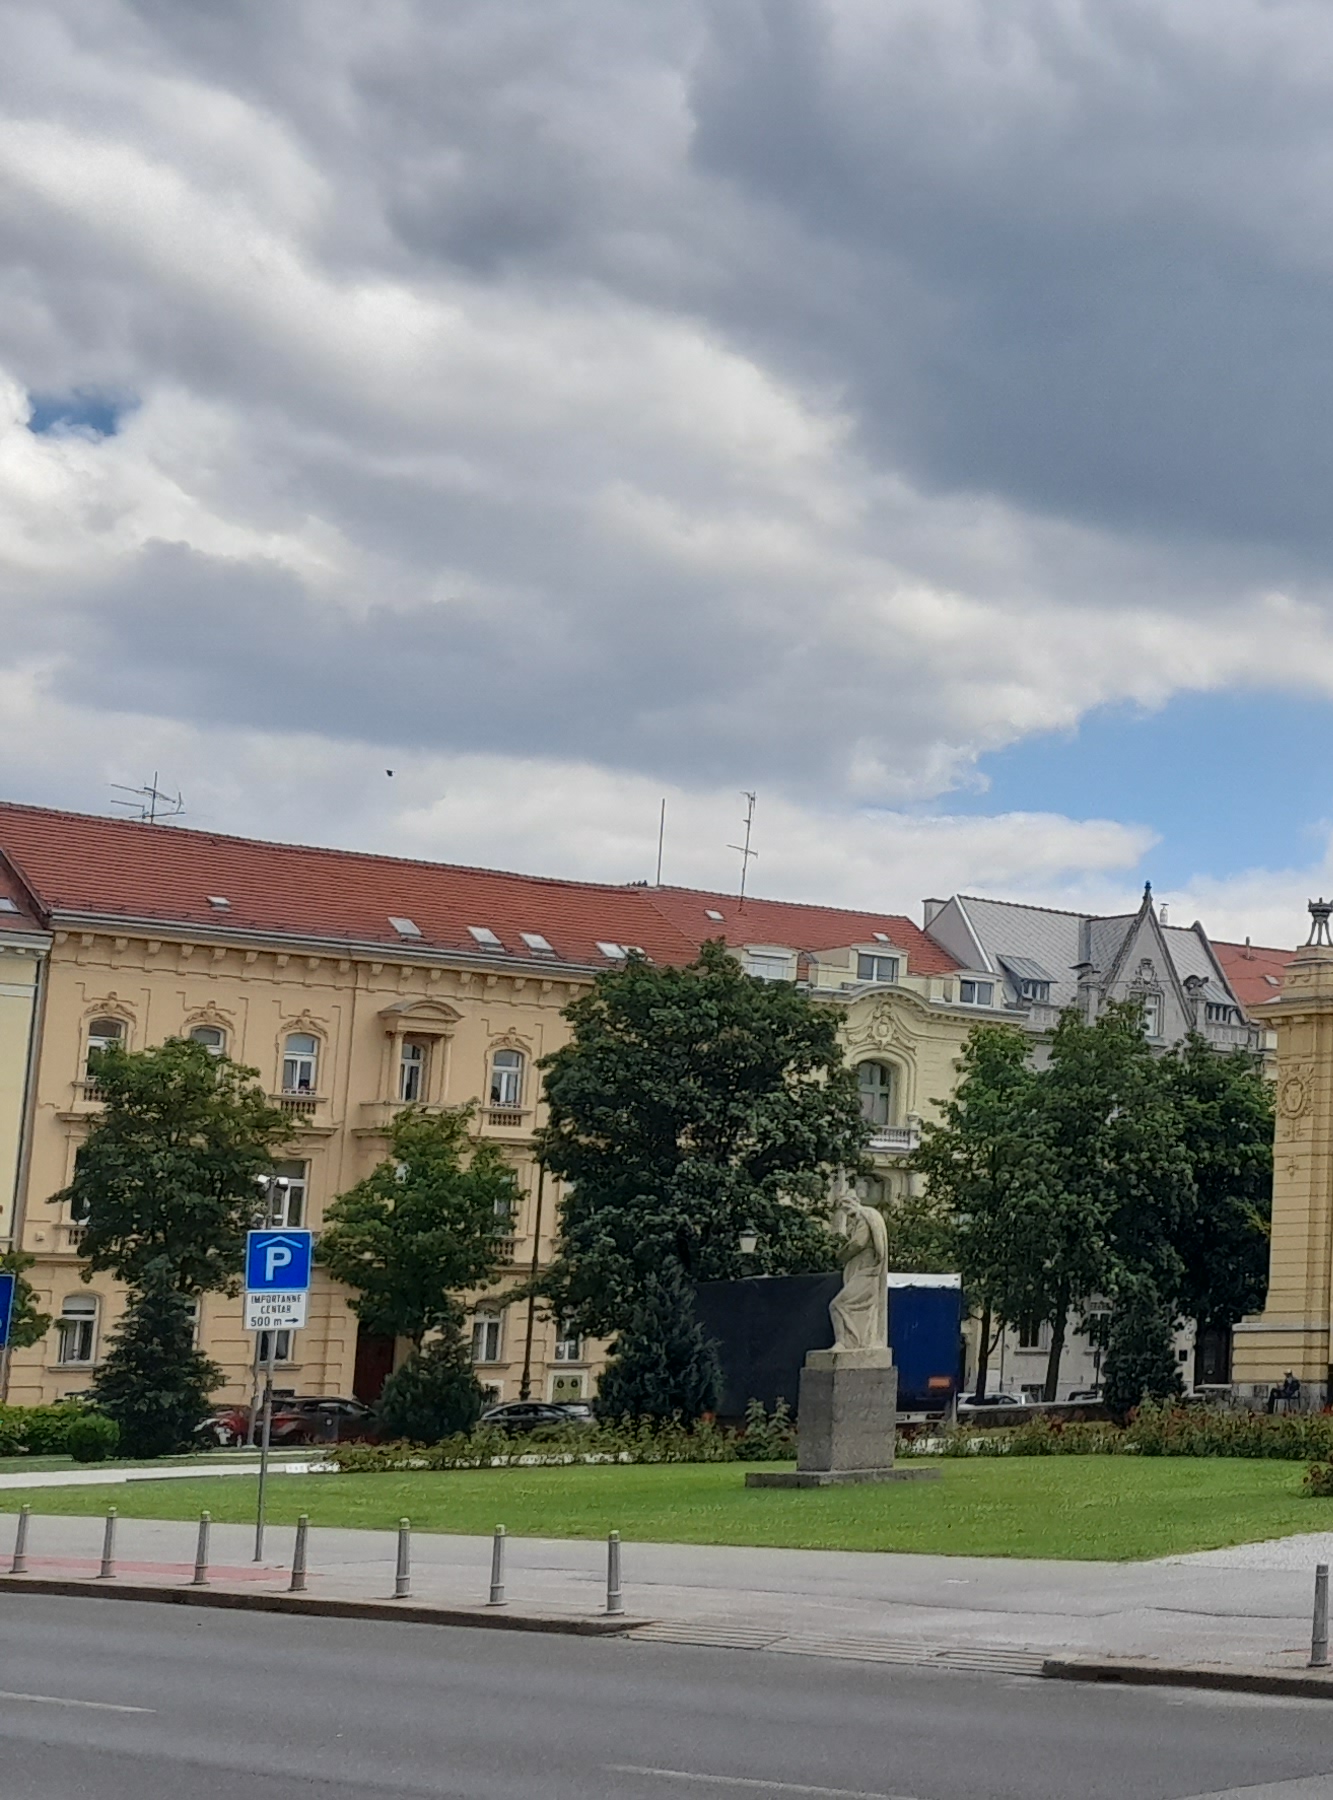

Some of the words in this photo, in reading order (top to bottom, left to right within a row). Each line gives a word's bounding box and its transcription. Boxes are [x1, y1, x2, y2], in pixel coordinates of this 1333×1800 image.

[265, 1246, 292, 1281] P
[251, 1294, 302, 1304] IMPORTANNE
[260, 1305, 292, 1314] CENTAR
[250, 1316, 271, 1327] 500
[273, 1318, 282, 1326] m
